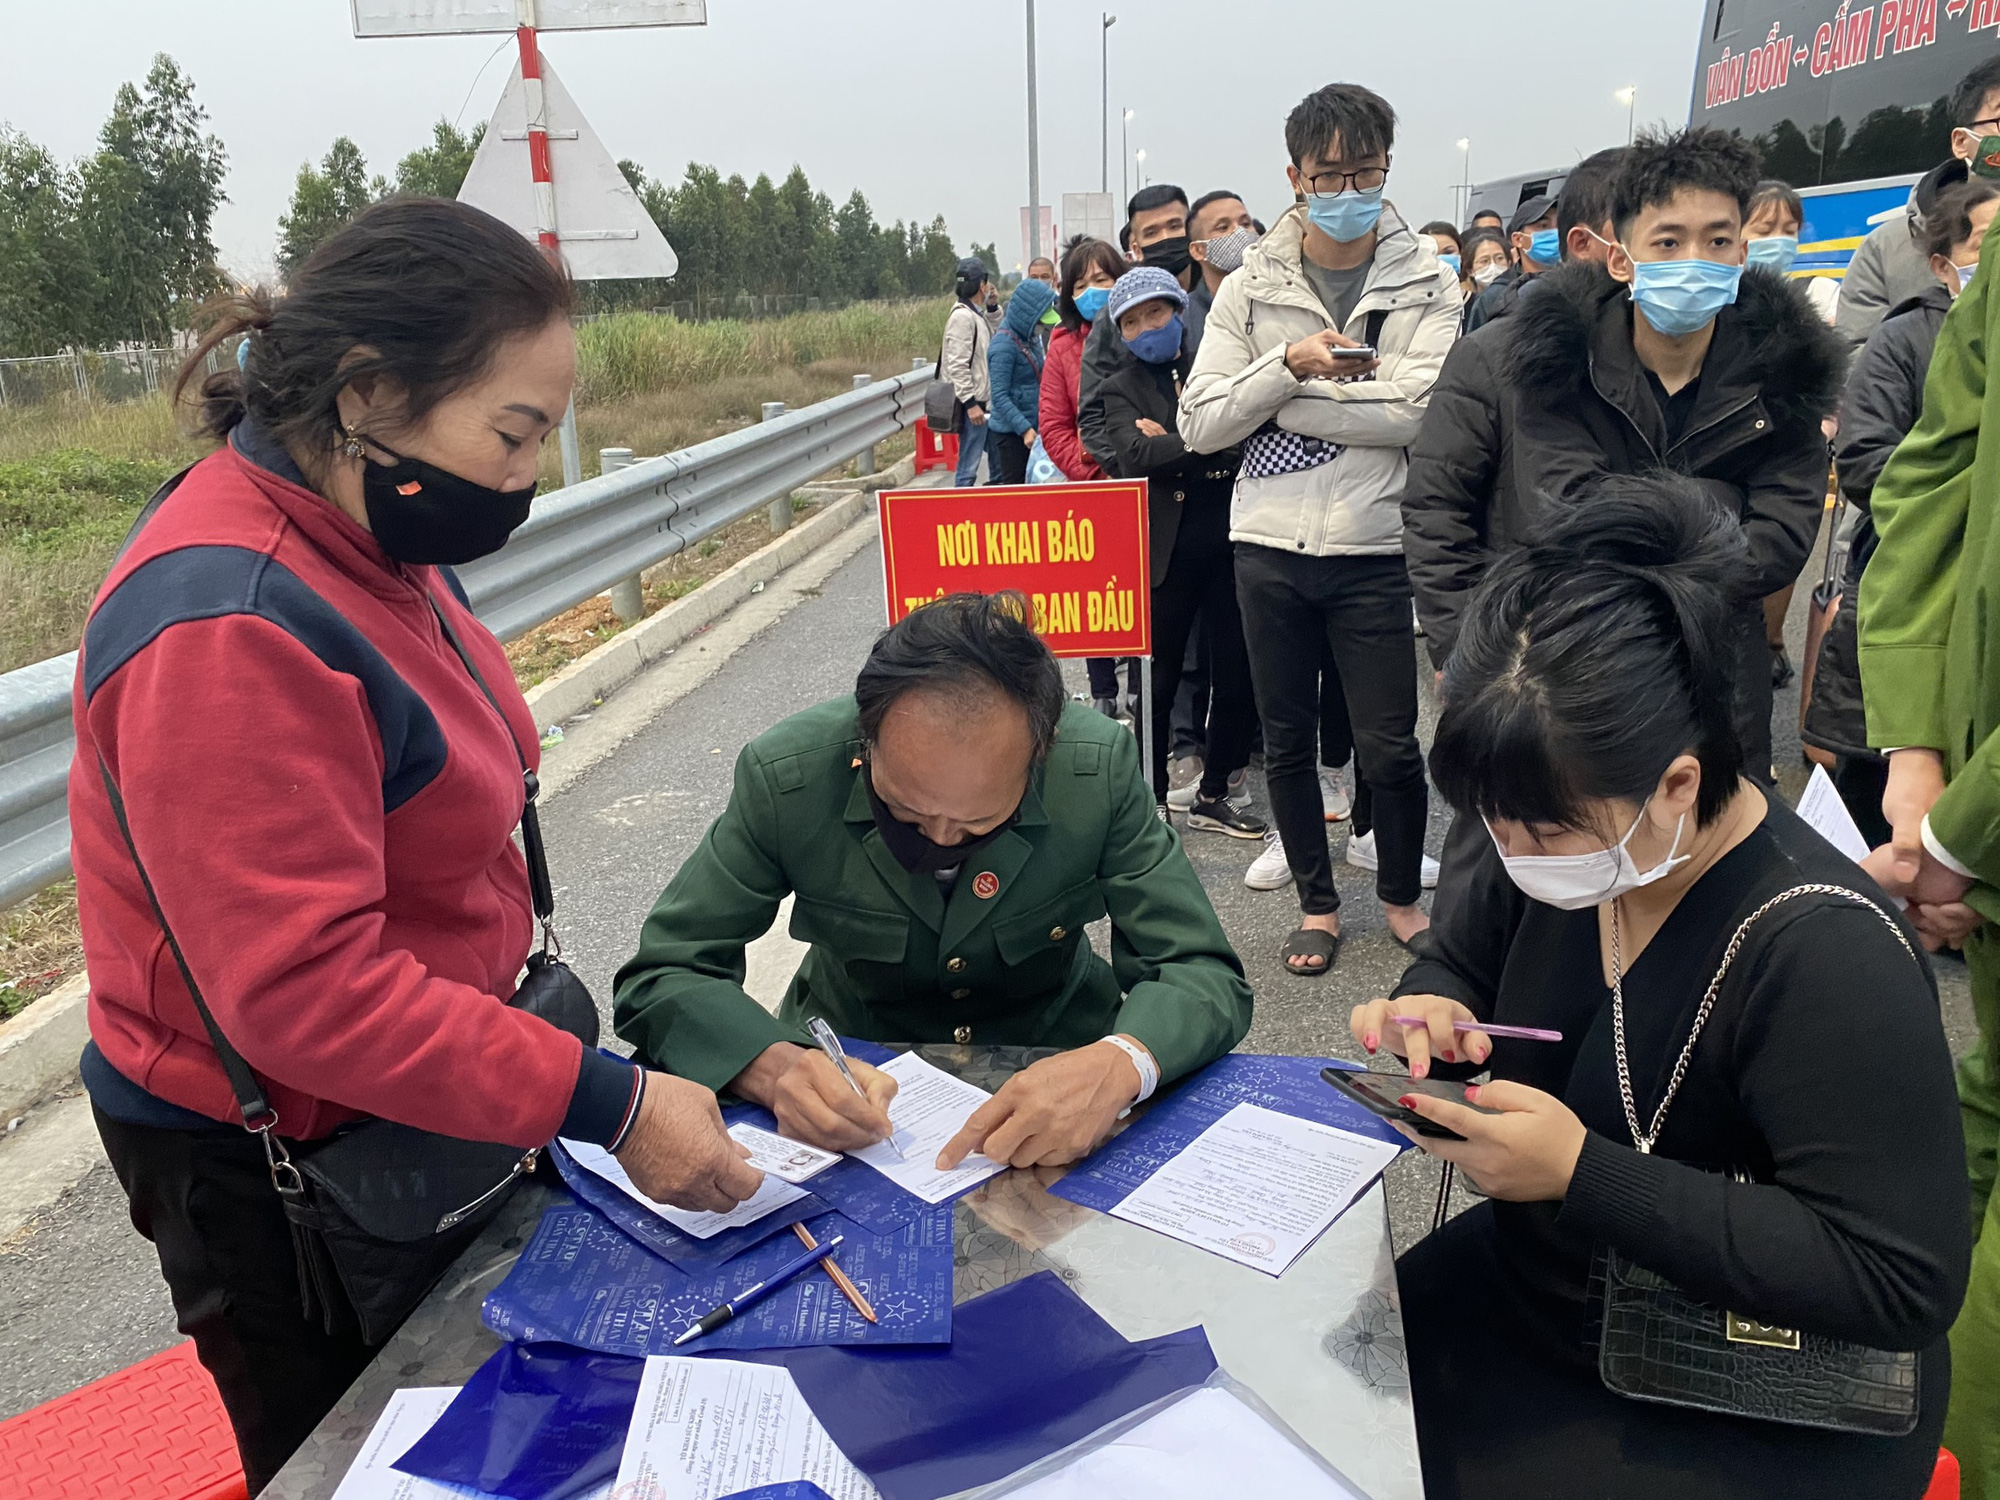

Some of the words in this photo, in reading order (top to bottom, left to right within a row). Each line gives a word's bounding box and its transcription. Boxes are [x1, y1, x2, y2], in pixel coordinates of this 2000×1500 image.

[1705, 46, 1745, 109] VÂN
[936, 520, 979, 567] NƠI
[984, 521, 1041, 565] KHAI
[1046, 509, 1095, 563] BÁO
[1032, 591, 1081, 635] BAN
[1086, 575, 1135, 633] ĐẦU
